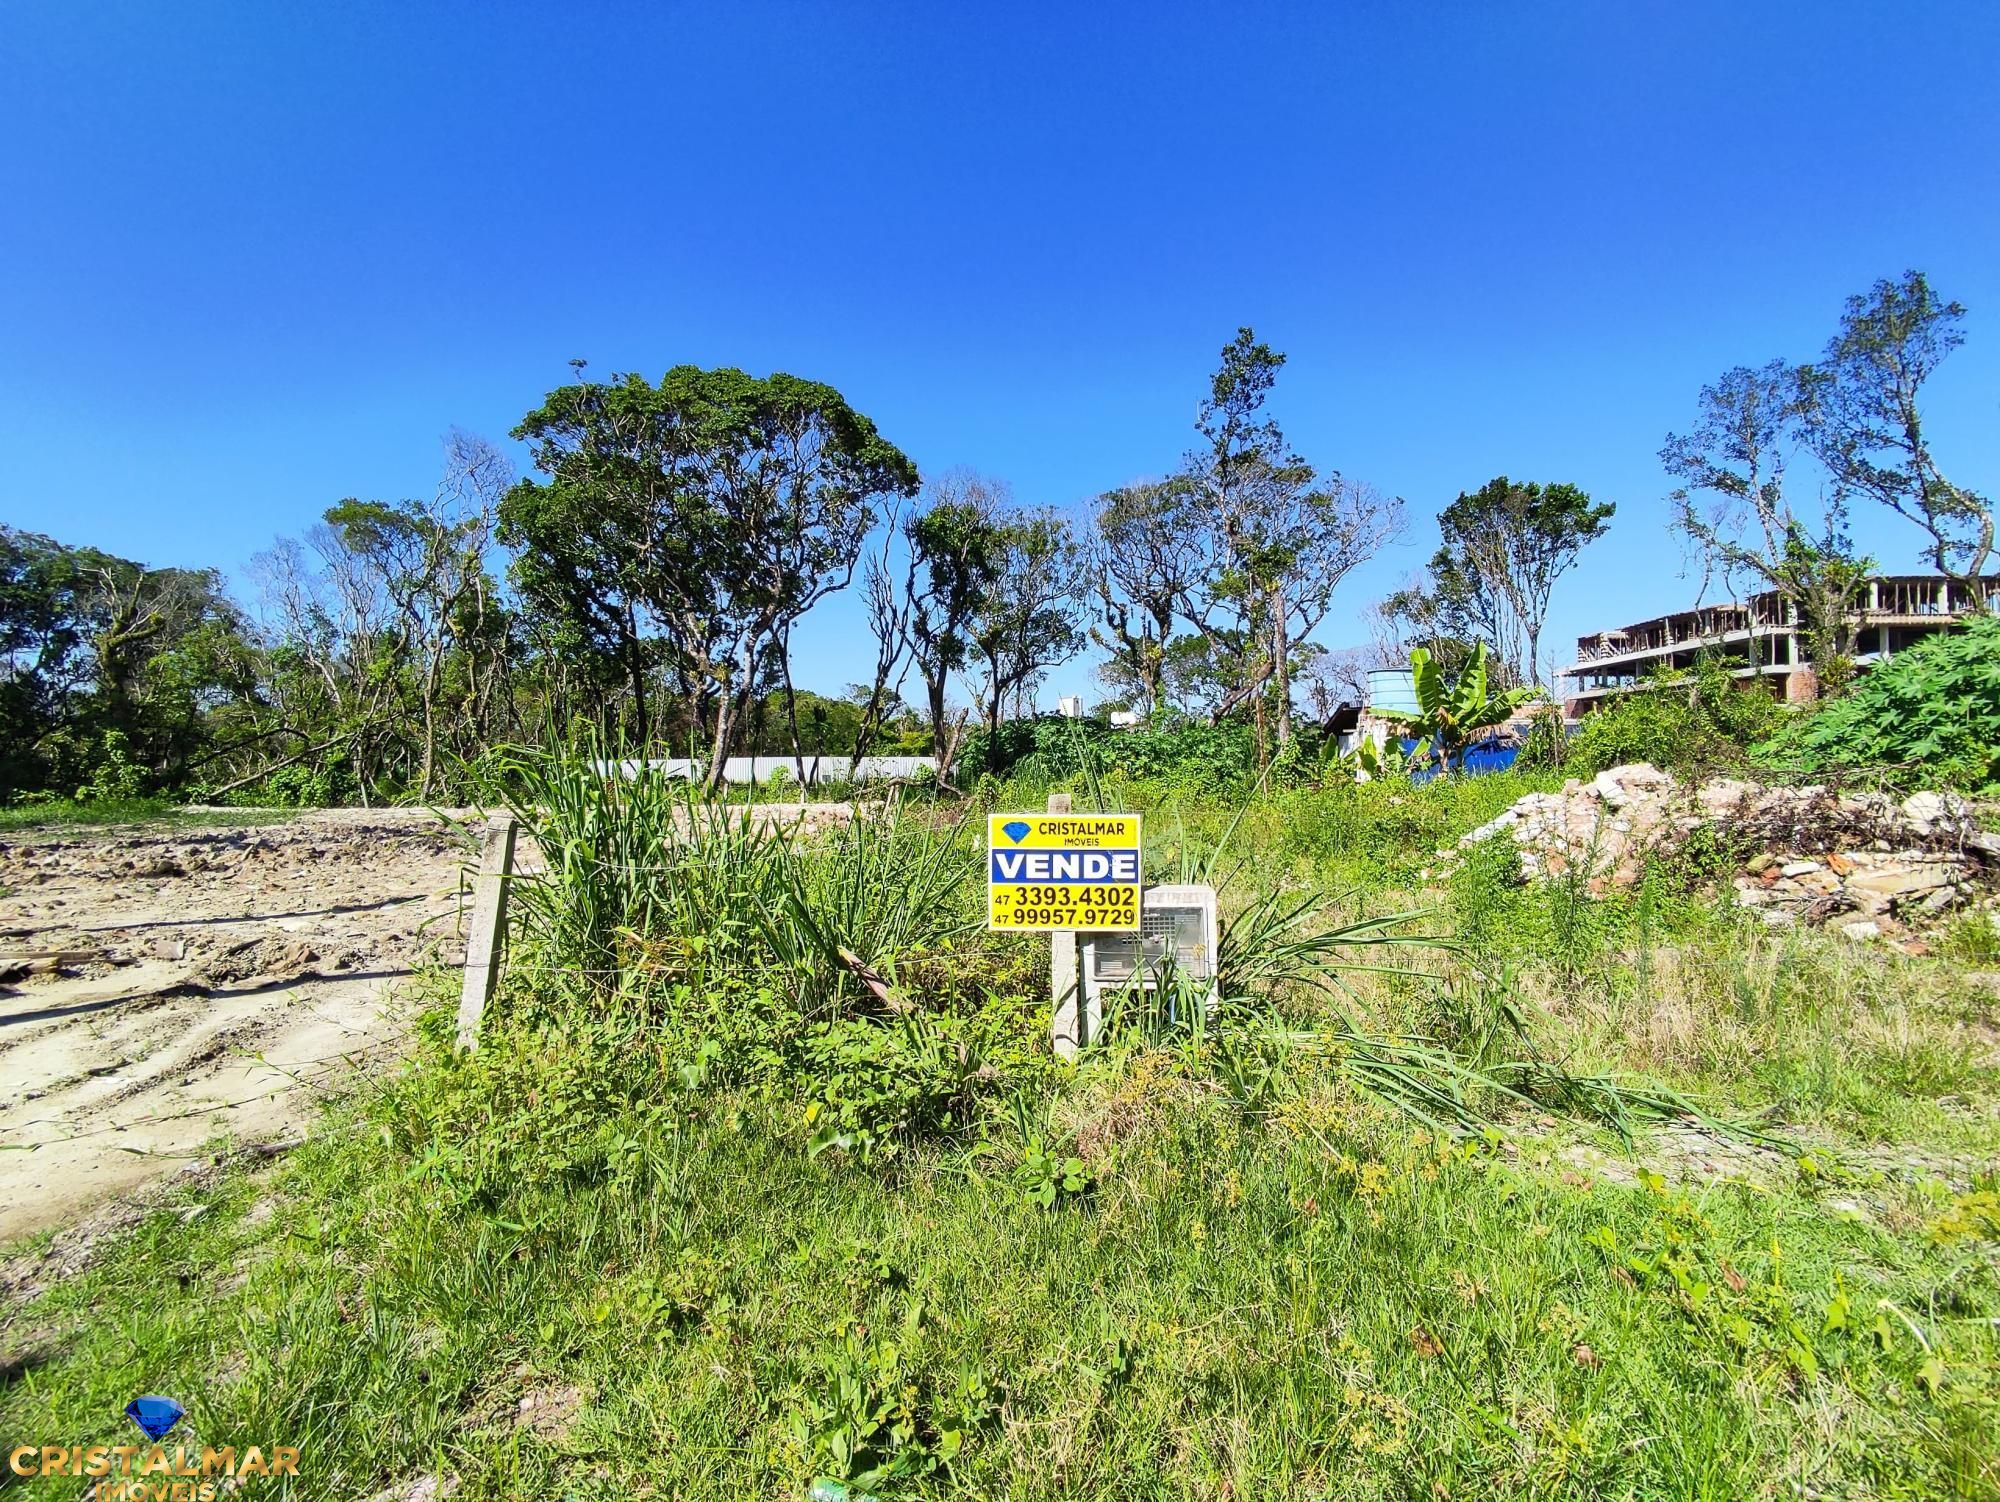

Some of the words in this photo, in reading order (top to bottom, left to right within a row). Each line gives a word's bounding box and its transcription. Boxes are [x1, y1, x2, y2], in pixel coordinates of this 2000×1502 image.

[1039, 822, 1125, 835] CRISTALMAR
[996, 854, 1135, 879] VENDE
[995, 895, 1010, 905] 47
[1015, 887, 1134, 906] 3393.4302
[994, 915, 1009, 924] 47
[1013, 909, 1135, 925] 99957.9729
